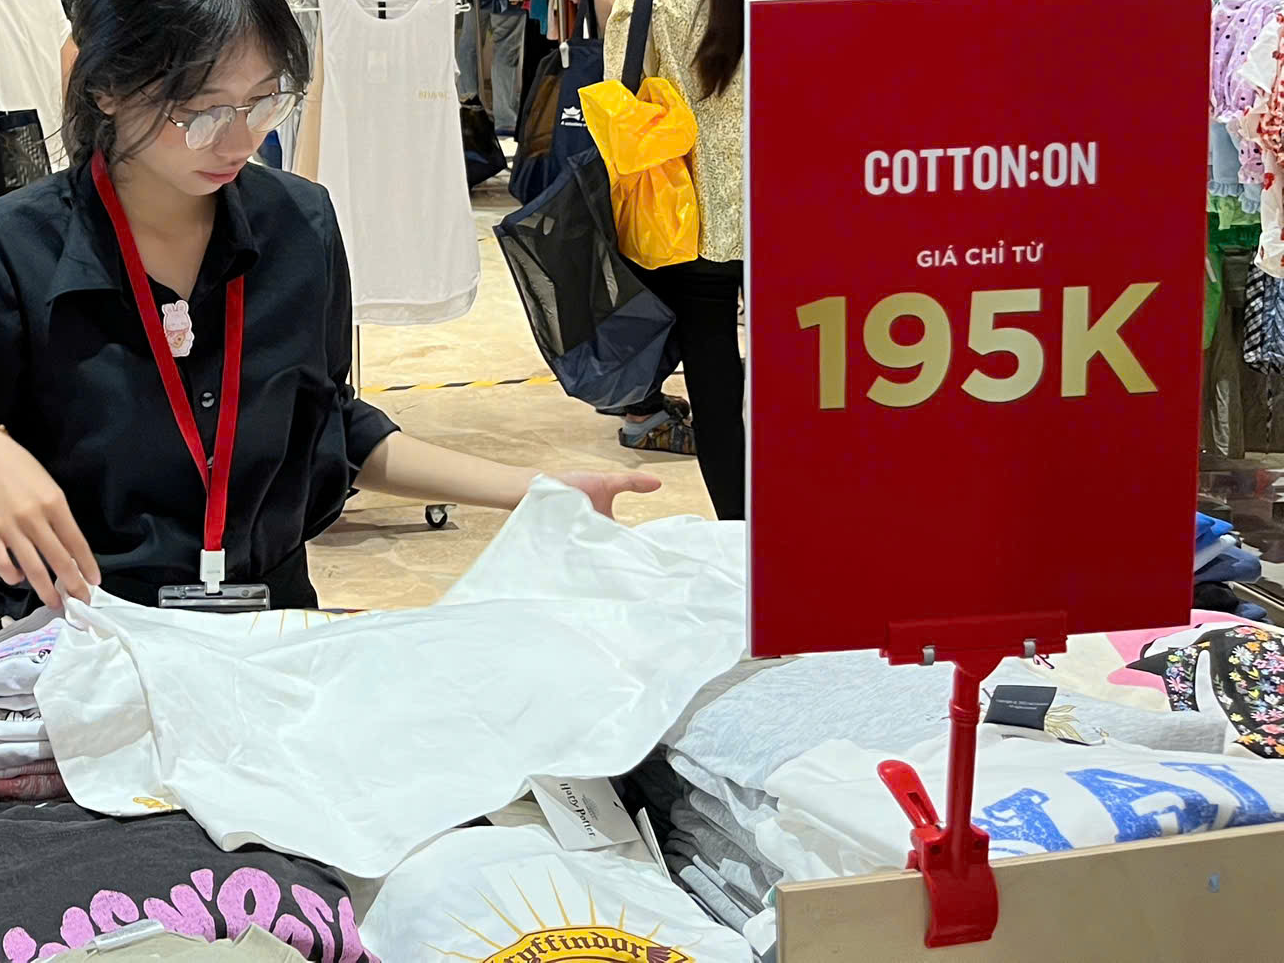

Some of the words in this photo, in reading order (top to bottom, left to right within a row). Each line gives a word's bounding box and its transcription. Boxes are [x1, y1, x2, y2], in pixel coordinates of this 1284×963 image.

[864, 142, 1097, 195] COTTON:ON
[916, 245, 958, 268] GIÁ
[965, 240, 1004, 267] CHỈ
[1012, 241, 1044, 264] TỪ
[795, 281, 1161, 410] 195K
[559, 782, 579, 810] Harry
[576, 808, 596, 837] Potter
[492, 931, 647, 963] ryffindor
